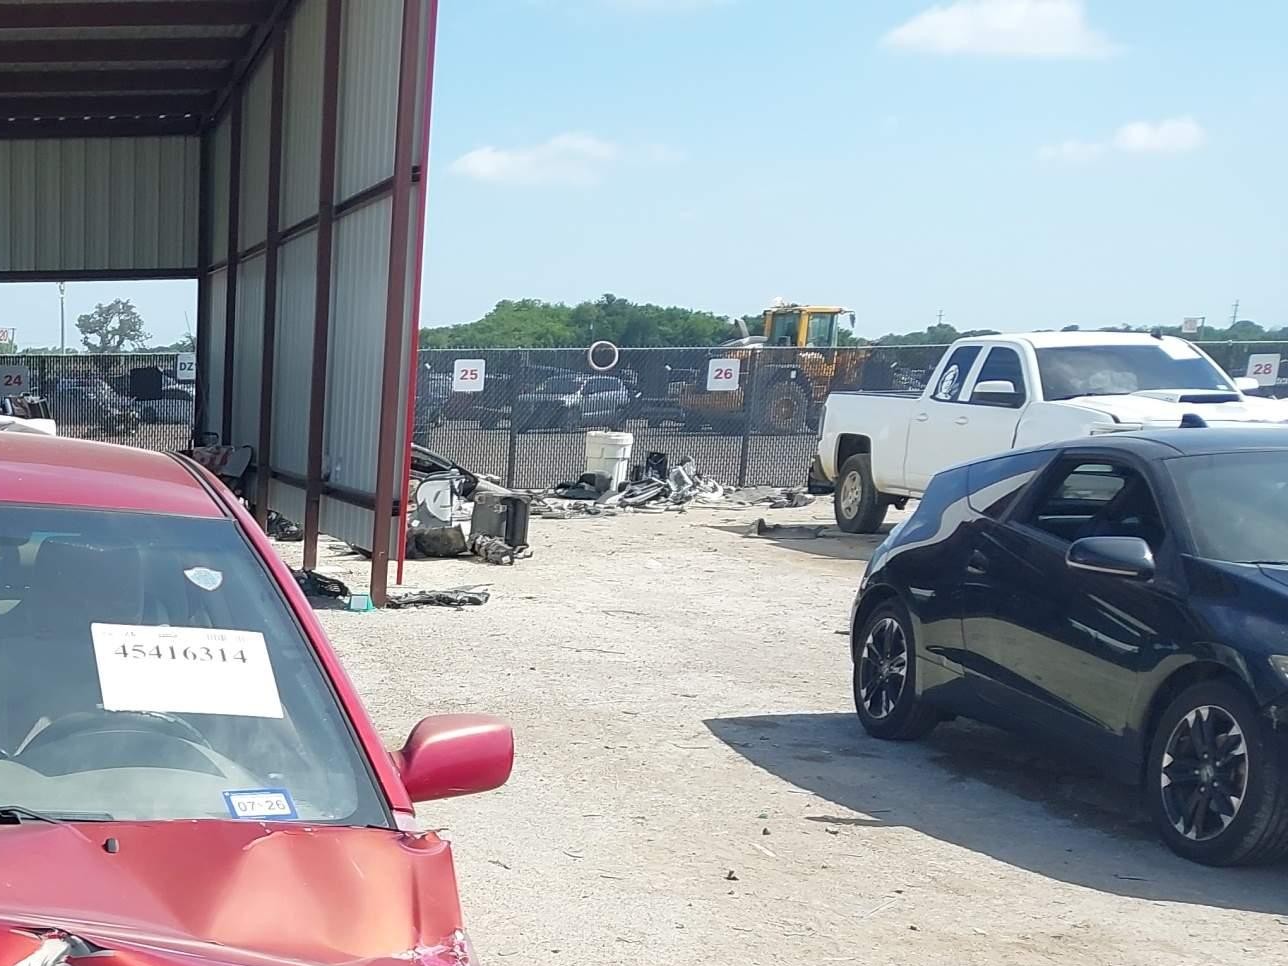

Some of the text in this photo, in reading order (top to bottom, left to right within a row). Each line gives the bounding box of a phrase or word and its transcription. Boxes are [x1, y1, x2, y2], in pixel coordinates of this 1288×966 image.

[179, 362, 194, 371] DZ
[1253, 363, 1273, 375] 28
[3, 374, 22, 386] 24
[459, 368, 479, 381] 25
[713, 368, 733, 380] 26
[114, 643, 248, 664] 45416314
